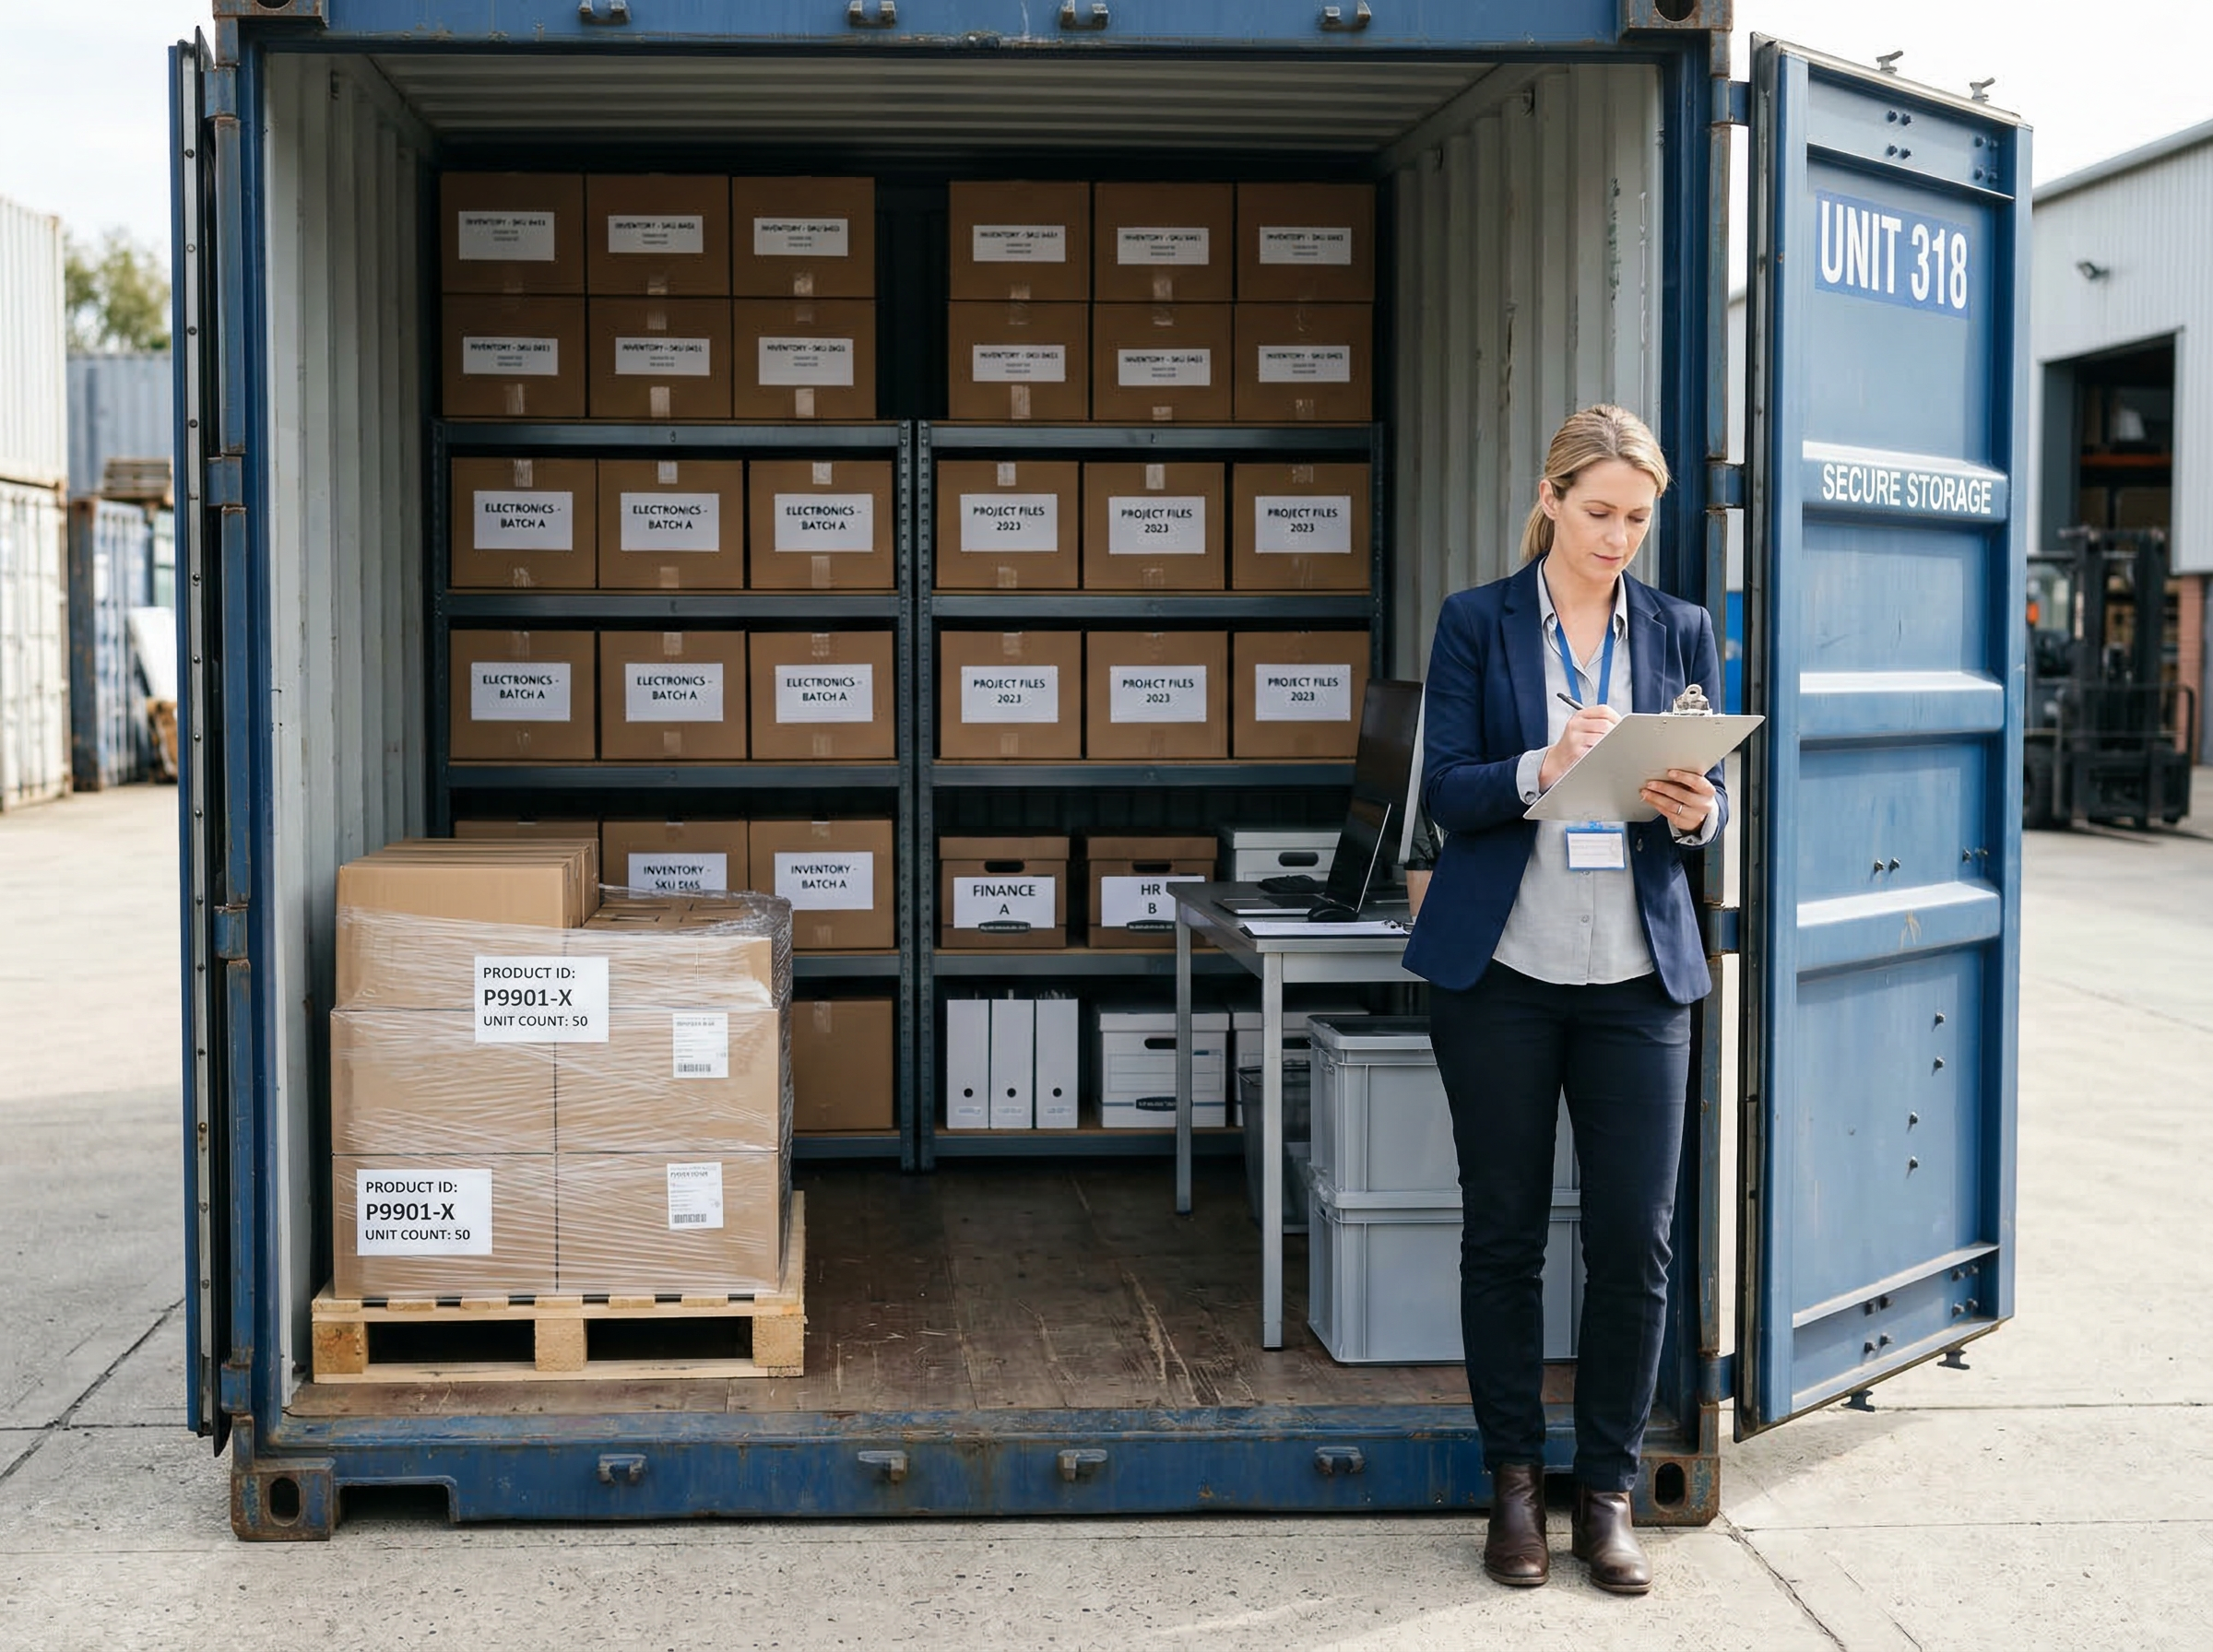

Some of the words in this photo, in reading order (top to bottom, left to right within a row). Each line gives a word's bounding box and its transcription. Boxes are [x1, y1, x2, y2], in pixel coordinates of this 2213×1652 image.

[1821, 200, 1901, 294] UNIT
[1911, 223, 1967, 310] 318
[1822, 463, 1900, 506] SECURE
[1907, 472, 1992, 514] STORAGE
[485, 503, 553, 513] ELECTRONICS
[633, 505, 701, 514] ELECTRONICS
[787, 506, 854, 515] ELECTRONICS
[974, 507, 1016, 516] PROJECT
[1020, 507, 1044, 515] FILES
[1122, 509, 1164, 519] PROJECT
[1167, 509, 1192, 518] FILES
[1268, 509, 1310, 518] PROJECT
[1313, 509, 1337, 517] FILES
[501, 518, 535, 528] BATCH
[538, 519, 545, 527] A
[649, 520, 682, 529] BATCH
[686, 521, 692, 529] A
[802, 521, 835, 530] BATCH
[483, 675, 552, 685] ELECTRONICS
[637, 677, 704, 685] ELECTRONICS
[787, 678, 855, 687] ELECTRONICS
[974, 679, 1016, 688] PROJECT
[1021, 679, 1045, 688] FILES
[1123, 679, 1165, 688] PROJECT
[1169, 679, 1193, 688] FILES
[1269, 678, 1310, 687] PROJECT
[1314, 678, 1338, 687] FILES
[500, 689, 534, 699] BATCH
[538, 690, 545, 699] A
[653, 690, 686, 700] BATCH
[803, 692, 836, 701] BATCH
[839, 692, 846, 701] A
[645, 866, 703, 875] INVENTORY
[792, 865, 849, 874] INVENTORY
[802, 880, 836, 889] BATCH
[1142, 884, 1160, 895] HR
[974, 885, 1035, 896] FINANCE
[1000, 904, 1009, 914] A
[1149, 903, 1156, 914] B
[484, 967, 551, 978] PRODUCT
[557, 968, 574, 978] ID:
[485, 989, 572, 1006] P9901-X
[484, 1016, 515, 1026] UNIT
[519, 1016, 568, 1026] COUNT:
[573, 1016, 587, 1026] 50
[367, 1182, 433, 1193] PRODUCT
[439, 1182, 456, 1192] ID:
[367, 1203, 455, 1220] P9901-X
[366, 1230, 397, 1240] UNIT
[401, 1230, 450, 1240] COUNT:
[456, 1230, 469, 1240] 50
